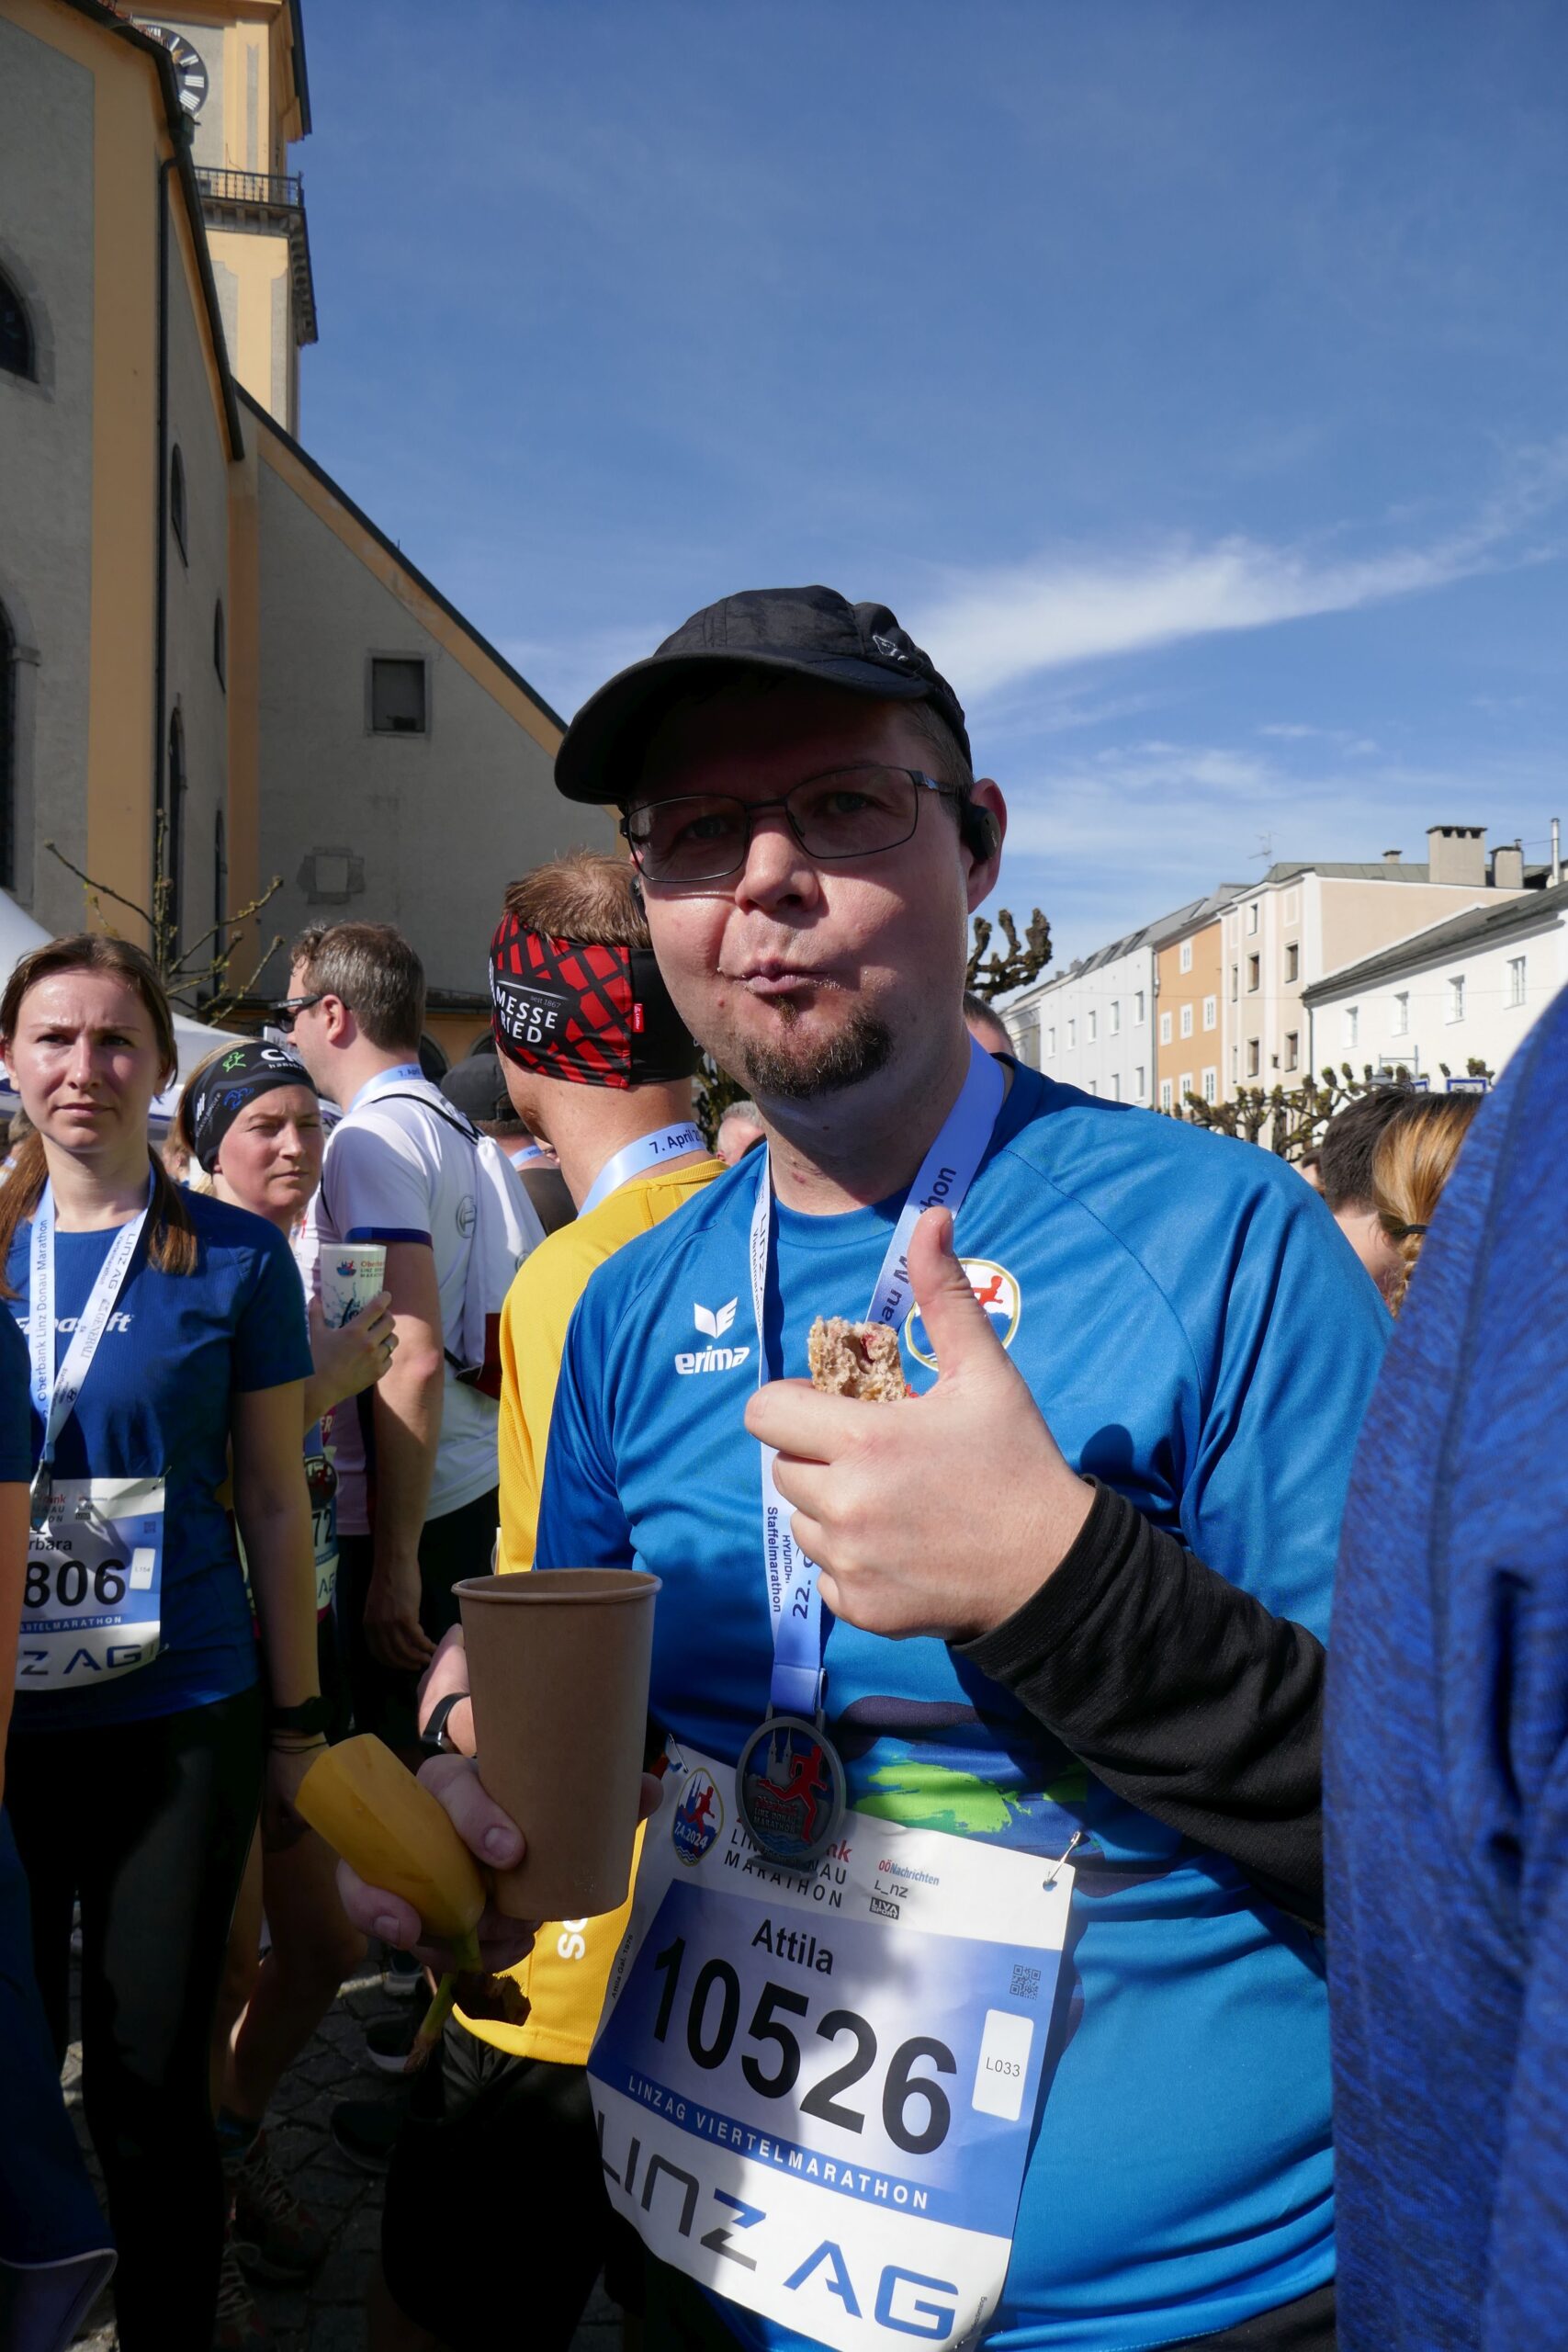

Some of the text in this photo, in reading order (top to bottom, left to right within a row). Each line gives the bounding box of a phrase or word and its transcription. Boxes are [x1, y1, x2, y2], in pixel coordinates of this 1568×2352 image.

[496, 986, 558, 1030] MESSE
[500, 1010, 543, 1044] RIED
[649, 1141, 665, 1154] 7.
[667, 1129, 694, 1149] April
[37, 1219, 48, 1271] Marathon
[37, 1273, 48, 1311] Donau
[37, 1314, 48, 1339] Linz
[35, 1340, 48, 1402] Oberbank
[675, 1345, 750, 1374] erima
[767, 1506, 782, 1613] Staffelmarathon
[793, 1579, 812, 1620] 22.
[62, 1644, 142, 1675] AG
[673, 1820, 709, 1849] 7.4.2024
[872, 1898, 898, 1914] LIVA
[751, 1918, 834, 1975] Attila
[653, 1936, 958, 2155] 10526
[985, 2056, 1021, 2078] L033
[695, 2111, 929, 2211] VIERTELMARATHON
[598, 2109, 959, 2341] LINZ AG
